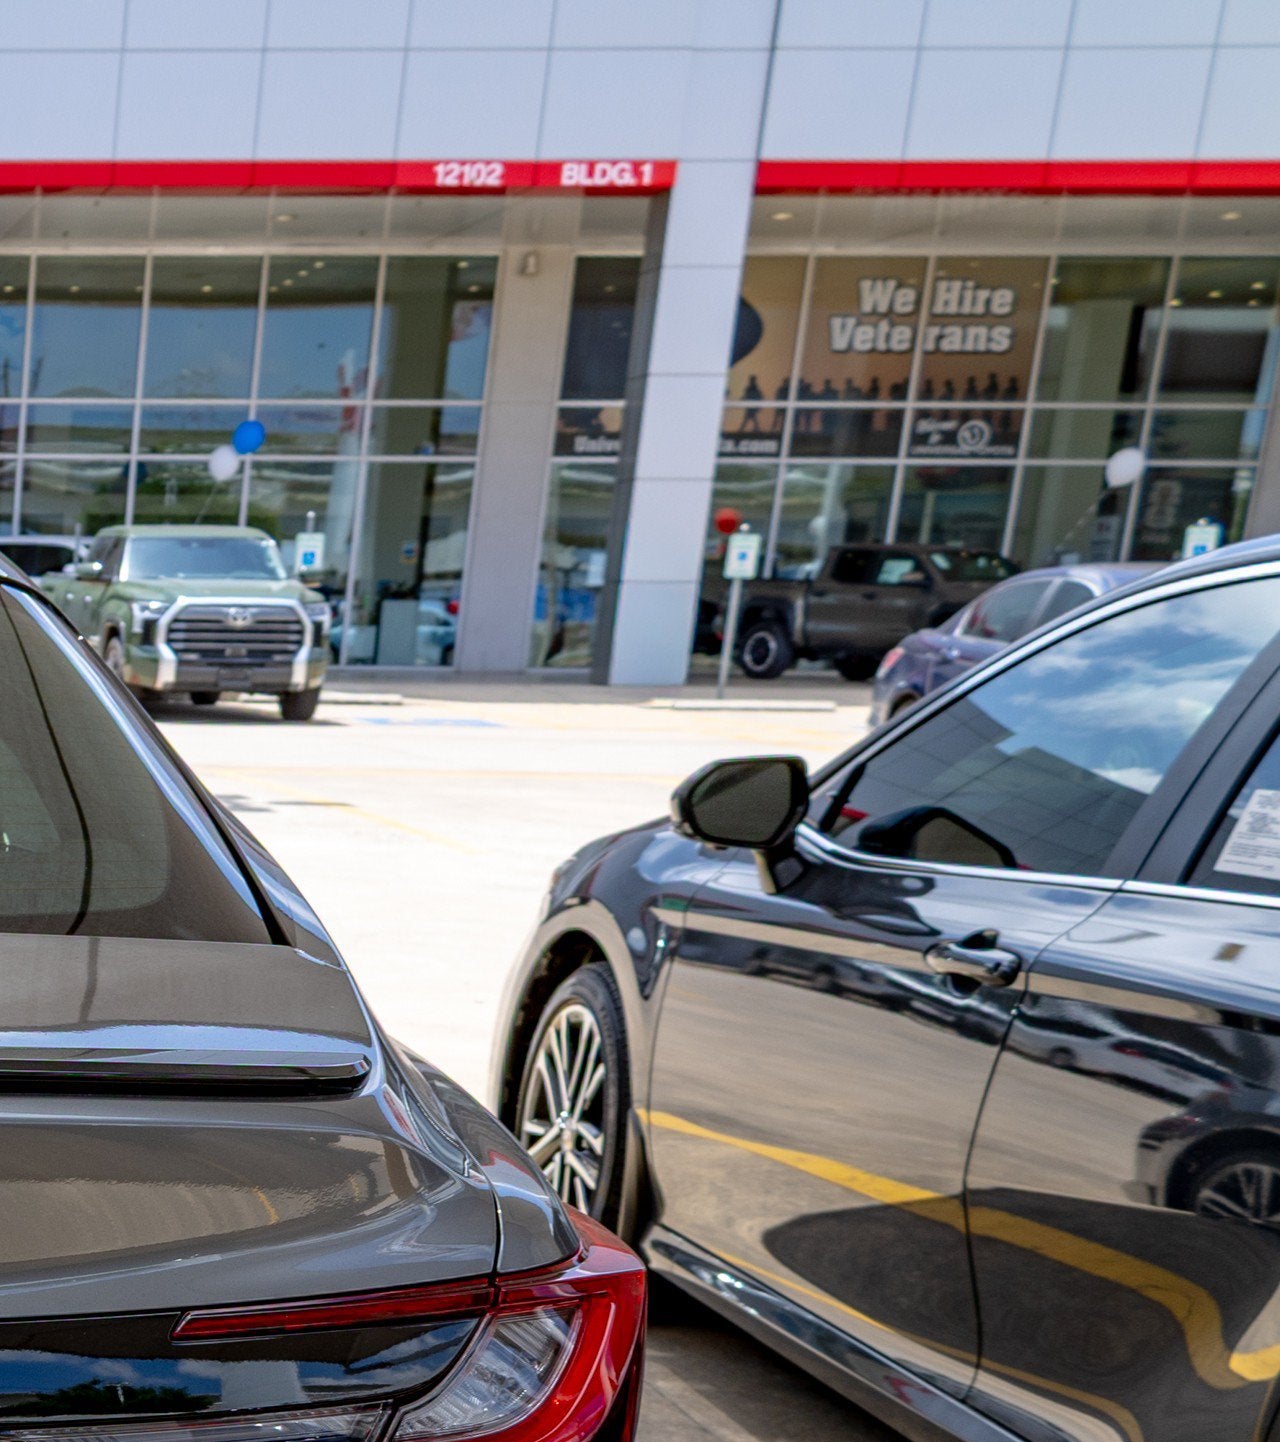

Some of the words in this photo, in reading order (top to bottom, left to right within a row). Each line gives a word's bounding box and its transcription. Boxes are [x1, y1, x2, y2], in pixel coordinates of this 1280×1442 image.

[434, 161, 505, 187] 12102
[560, 161, 637, 187] BLDG.
[639, 161, 654, 186] 1
[858, 278, 918, 315] We
[931, 279, 1016, 316] Hire
[829, 315, 1013, 353] Veterans
